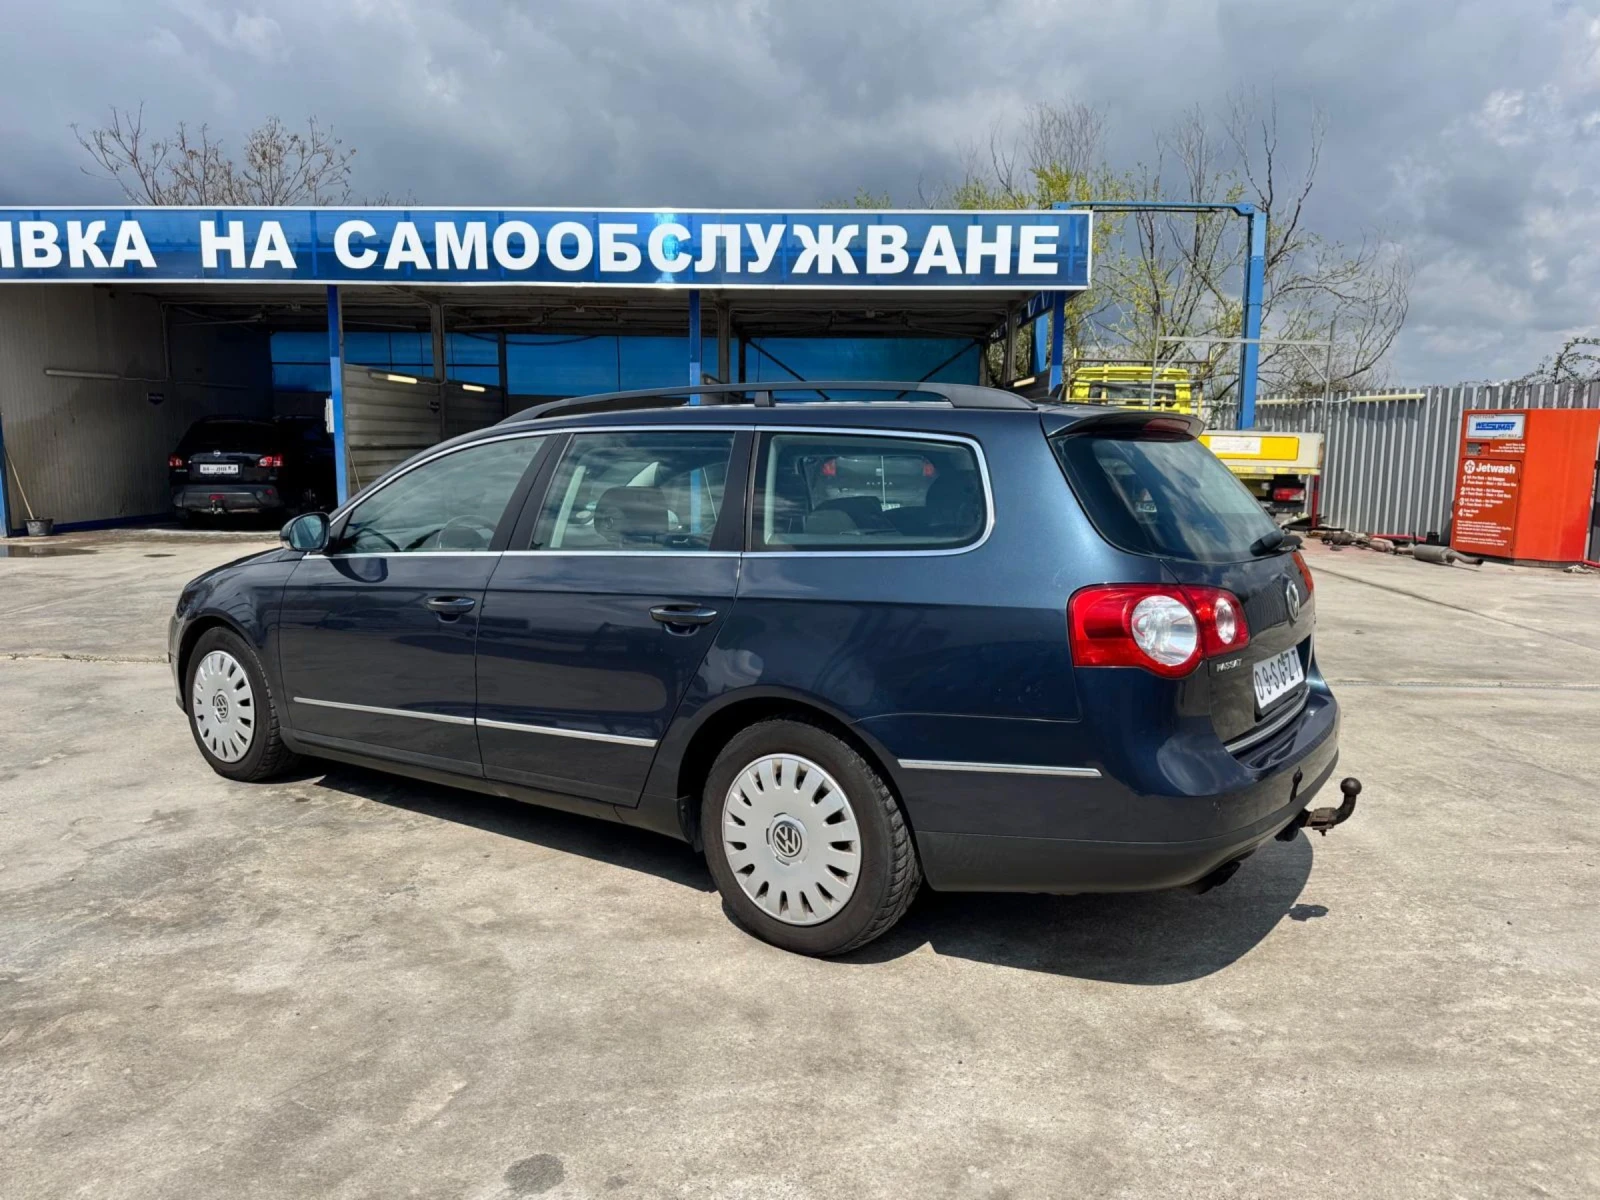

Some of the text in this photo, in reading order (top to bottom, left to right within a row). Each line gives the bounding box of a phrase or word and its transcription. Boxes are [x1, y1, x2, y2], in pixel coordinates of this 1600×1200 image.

[201, 221, 297, 269] НА
[335, 221, 1059, 275] САМООБСЛУЖВАНЕ
[1476, 463, 1516, 474] Jetwash
